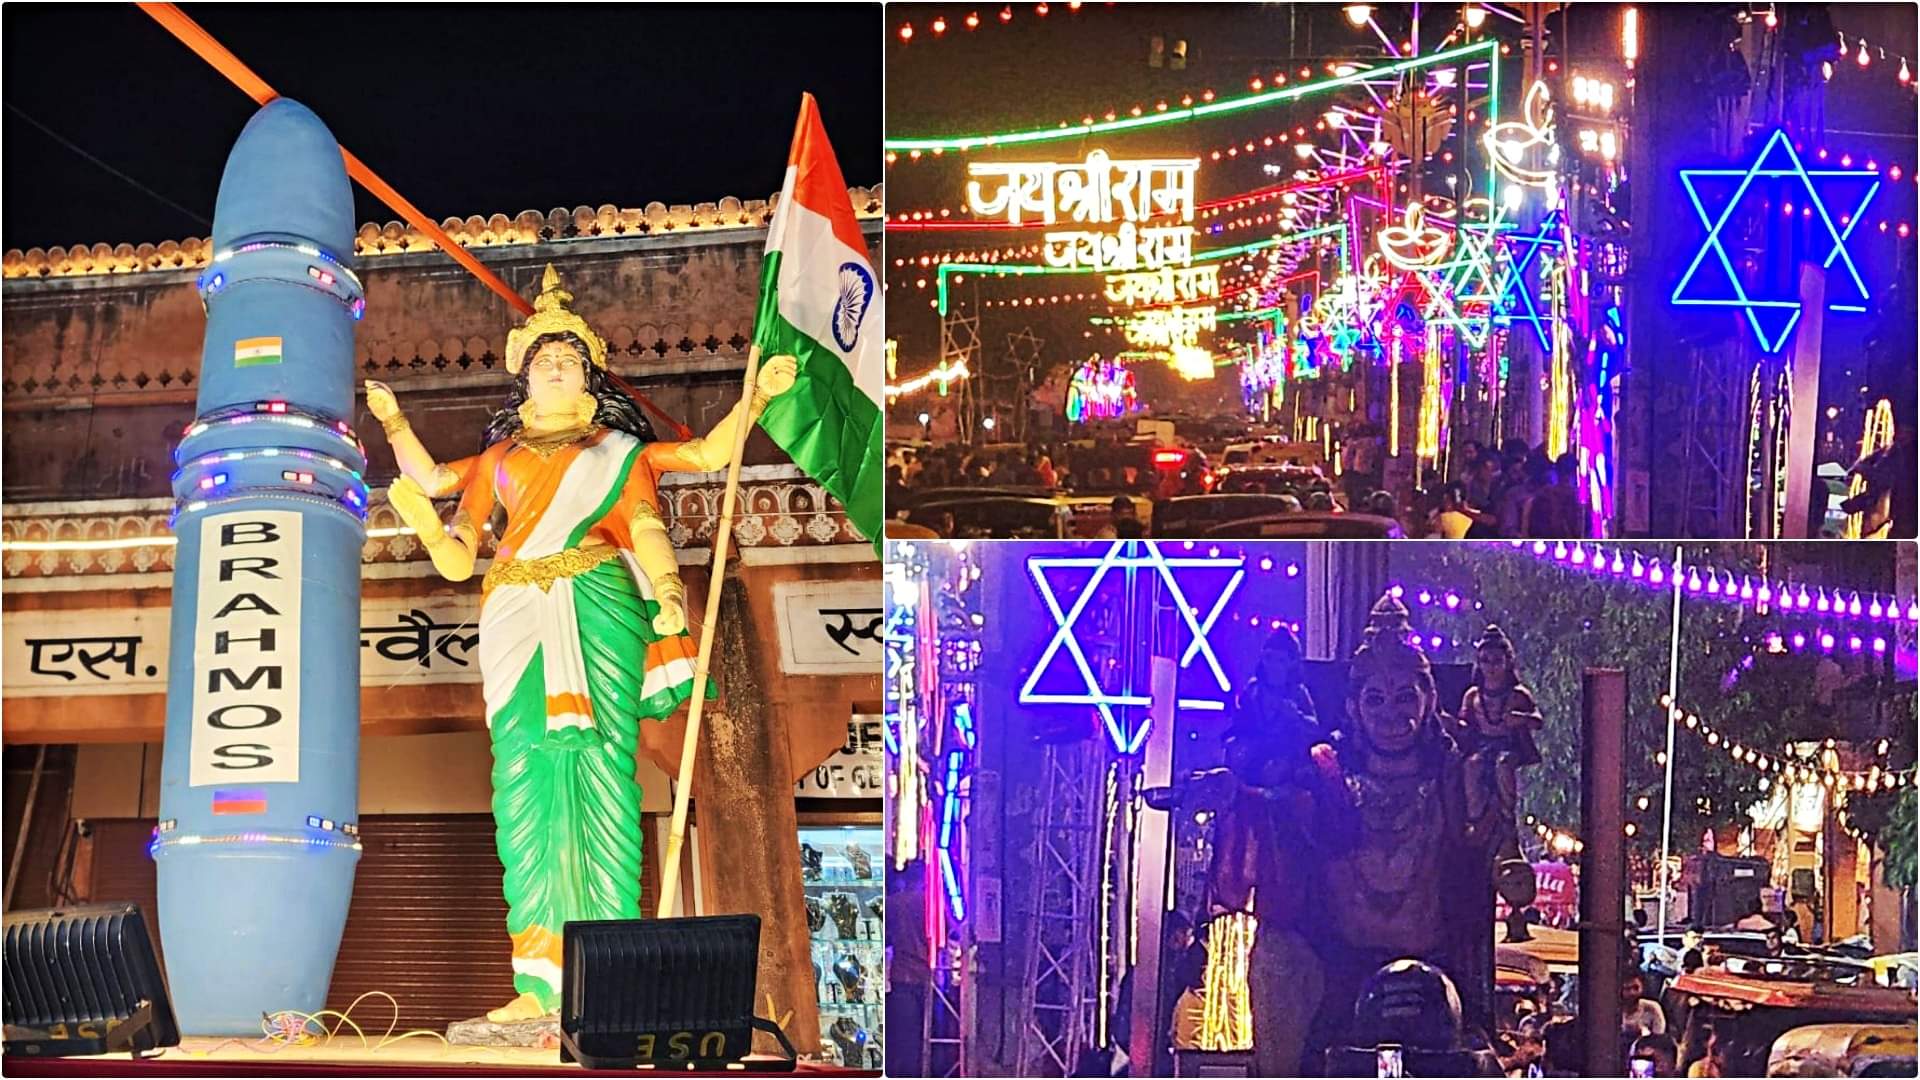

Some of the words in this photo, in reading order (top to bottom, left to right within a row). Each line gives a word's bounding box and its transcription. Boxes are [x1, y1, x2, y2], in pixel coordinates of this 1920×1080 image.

[25, 636, 158, 680] एस.
[360, 608, 480, 668] वैल
[206, 521, 282, 770] BRAHMOS
